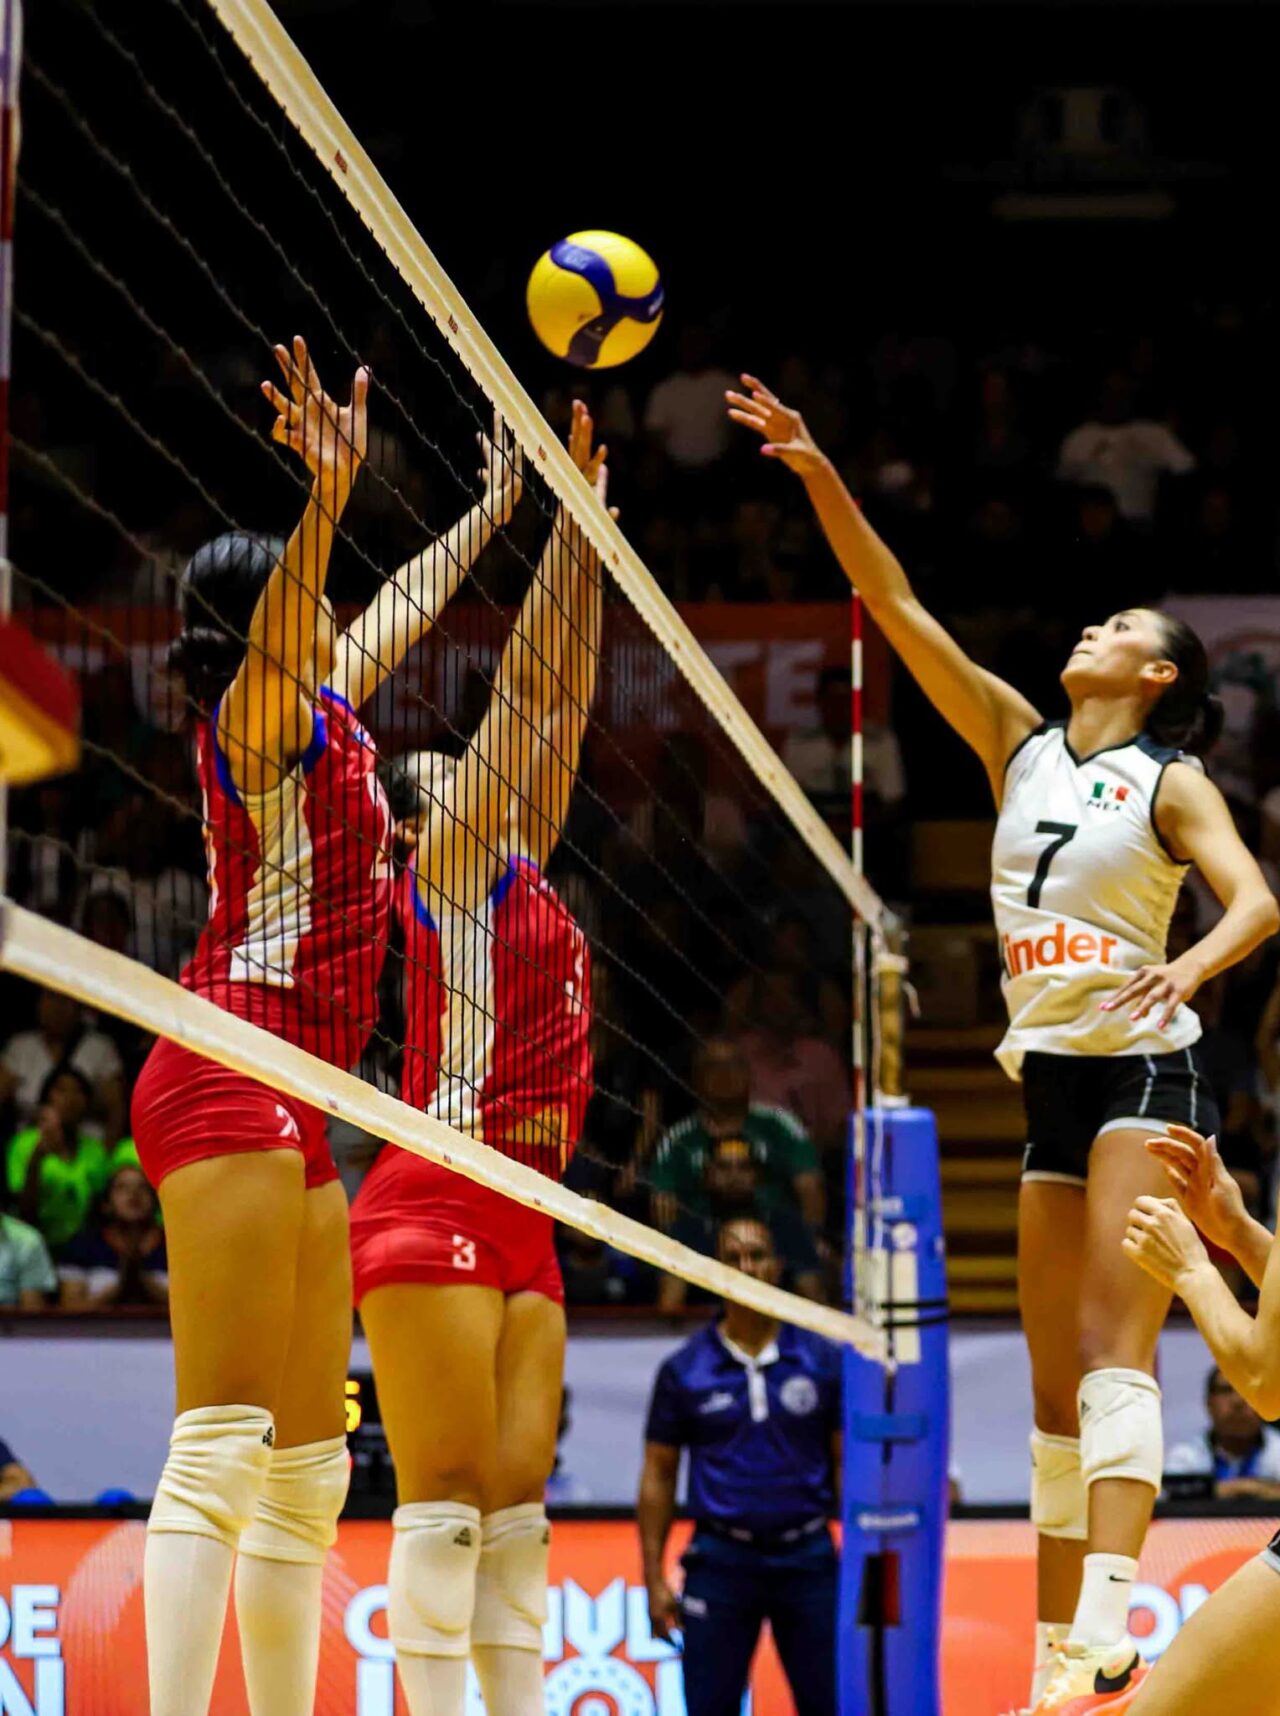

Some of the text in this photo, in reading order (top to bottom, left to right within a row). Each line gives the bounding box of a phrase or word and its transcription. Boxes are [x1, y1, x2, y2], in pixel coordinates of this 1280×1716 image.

[1027, 821, 1078, 908] 7
[1003, 922, 1117, 979] inder
[452, 1233, 476, 1271] 3
